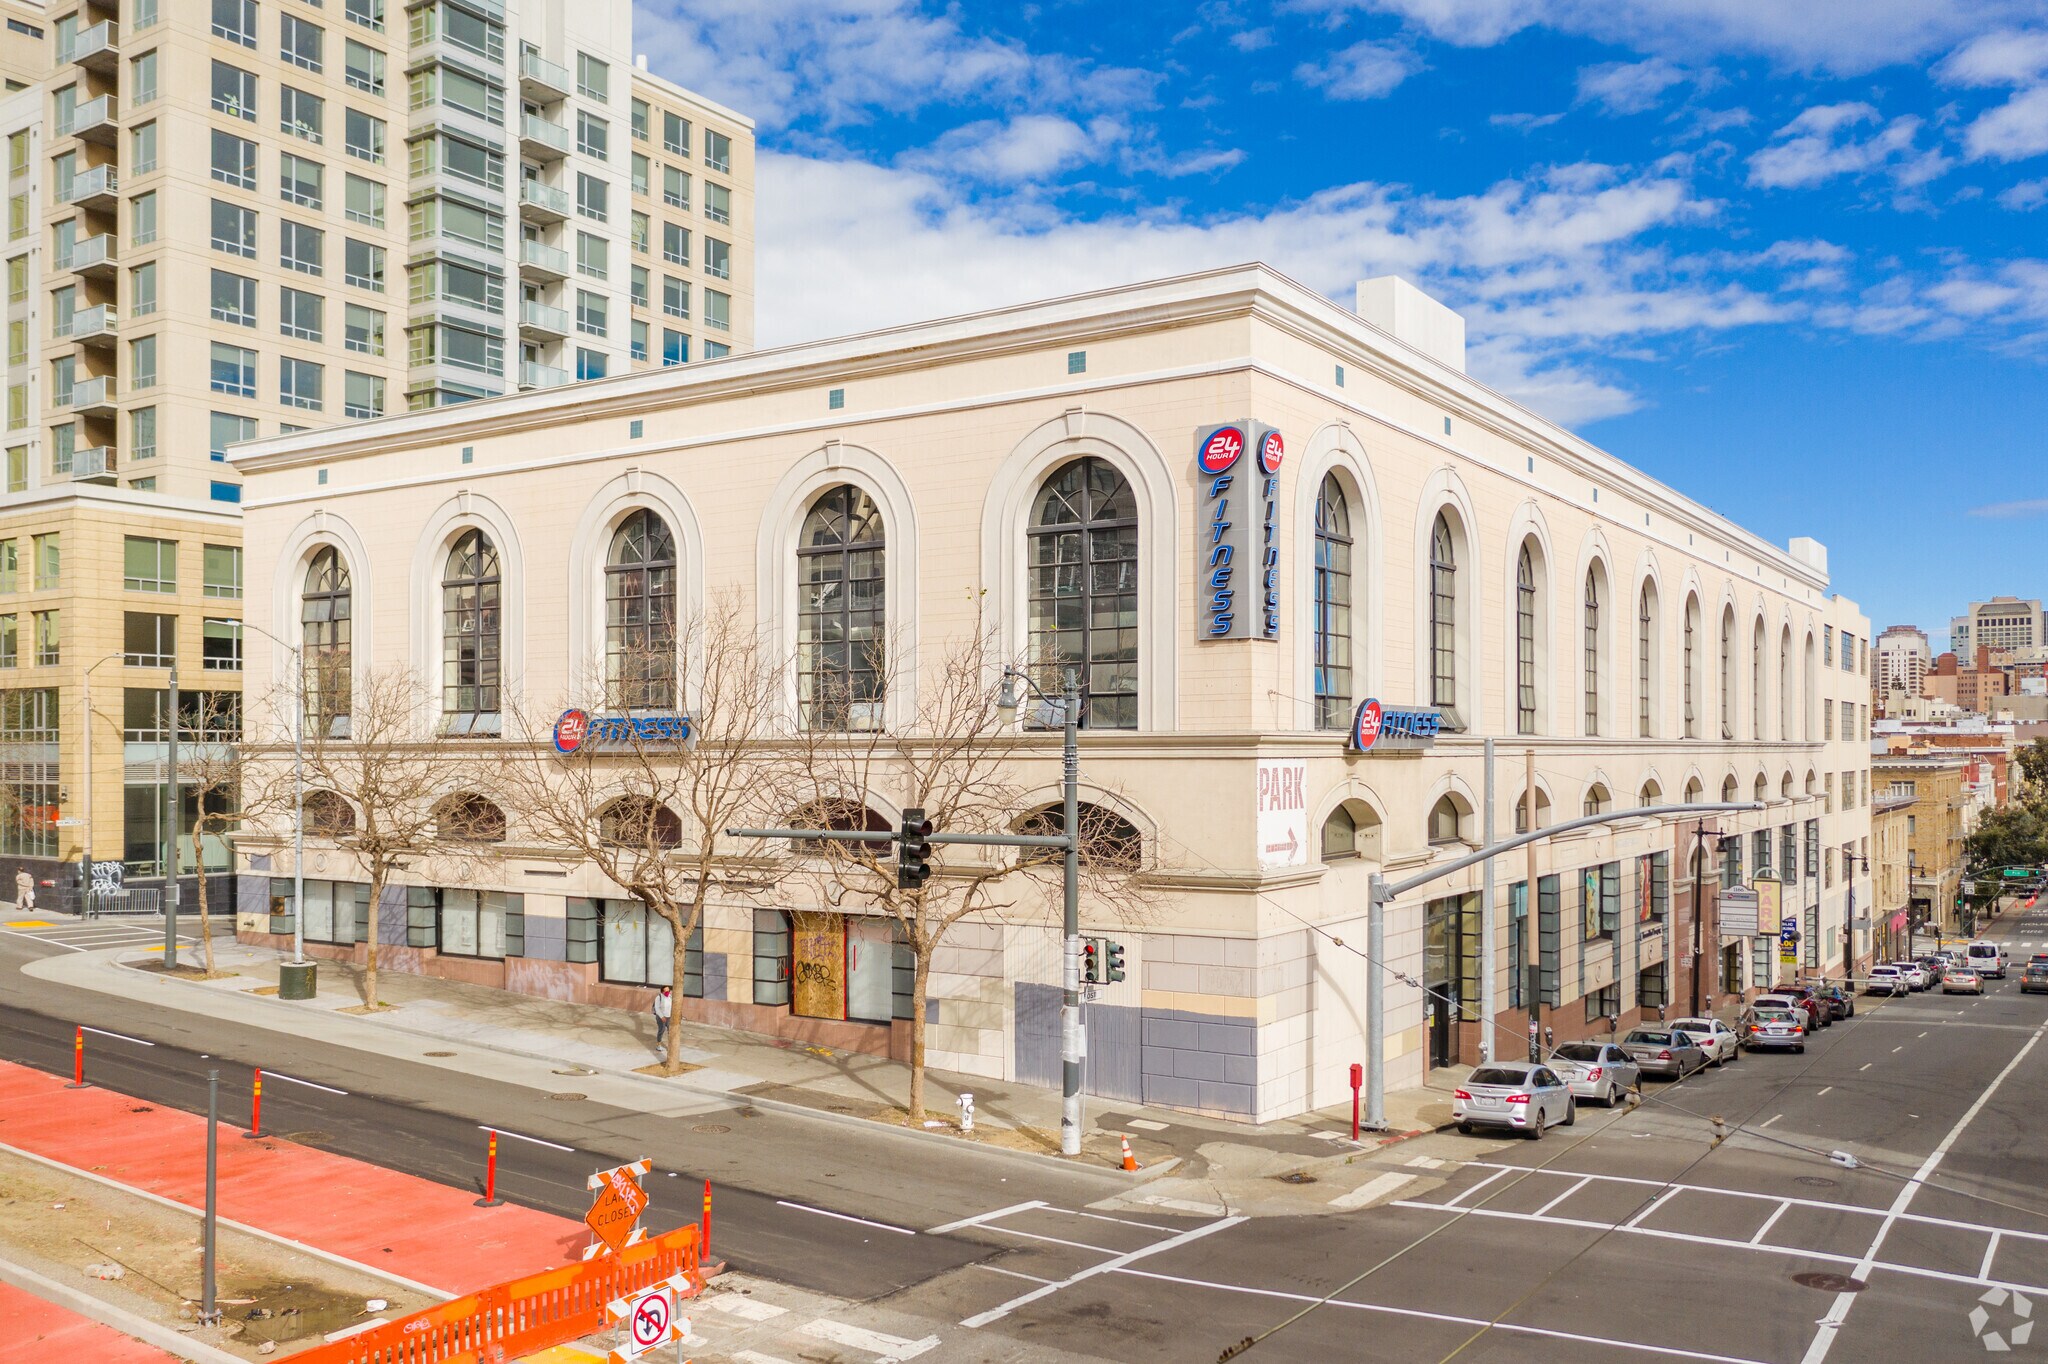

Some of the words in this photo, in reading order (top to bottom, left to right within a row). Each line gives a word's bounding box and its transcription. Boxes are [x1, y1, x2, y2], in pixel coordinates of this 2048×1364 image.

[1207, 453, 1229, 461] HOUR
[1209, 437, 1240, 458] 24
[1265, 453, 1278, 461] HOUR
[1266, 438, 1283, 462] 24
[1210, 475, 1234, 634] FITNESS
[1265, 479, 1279, 634] FITNESS
[562, 719, 585, 740] 24
[587, 717, 690, 740] FITNESS
[1363, 710, 1380, 734] 24
[1380, 710, 1440, 735] FITNESS
[1259, 767, 1304, 811] PARK
[1761, 884, 1772, 931] PARK
